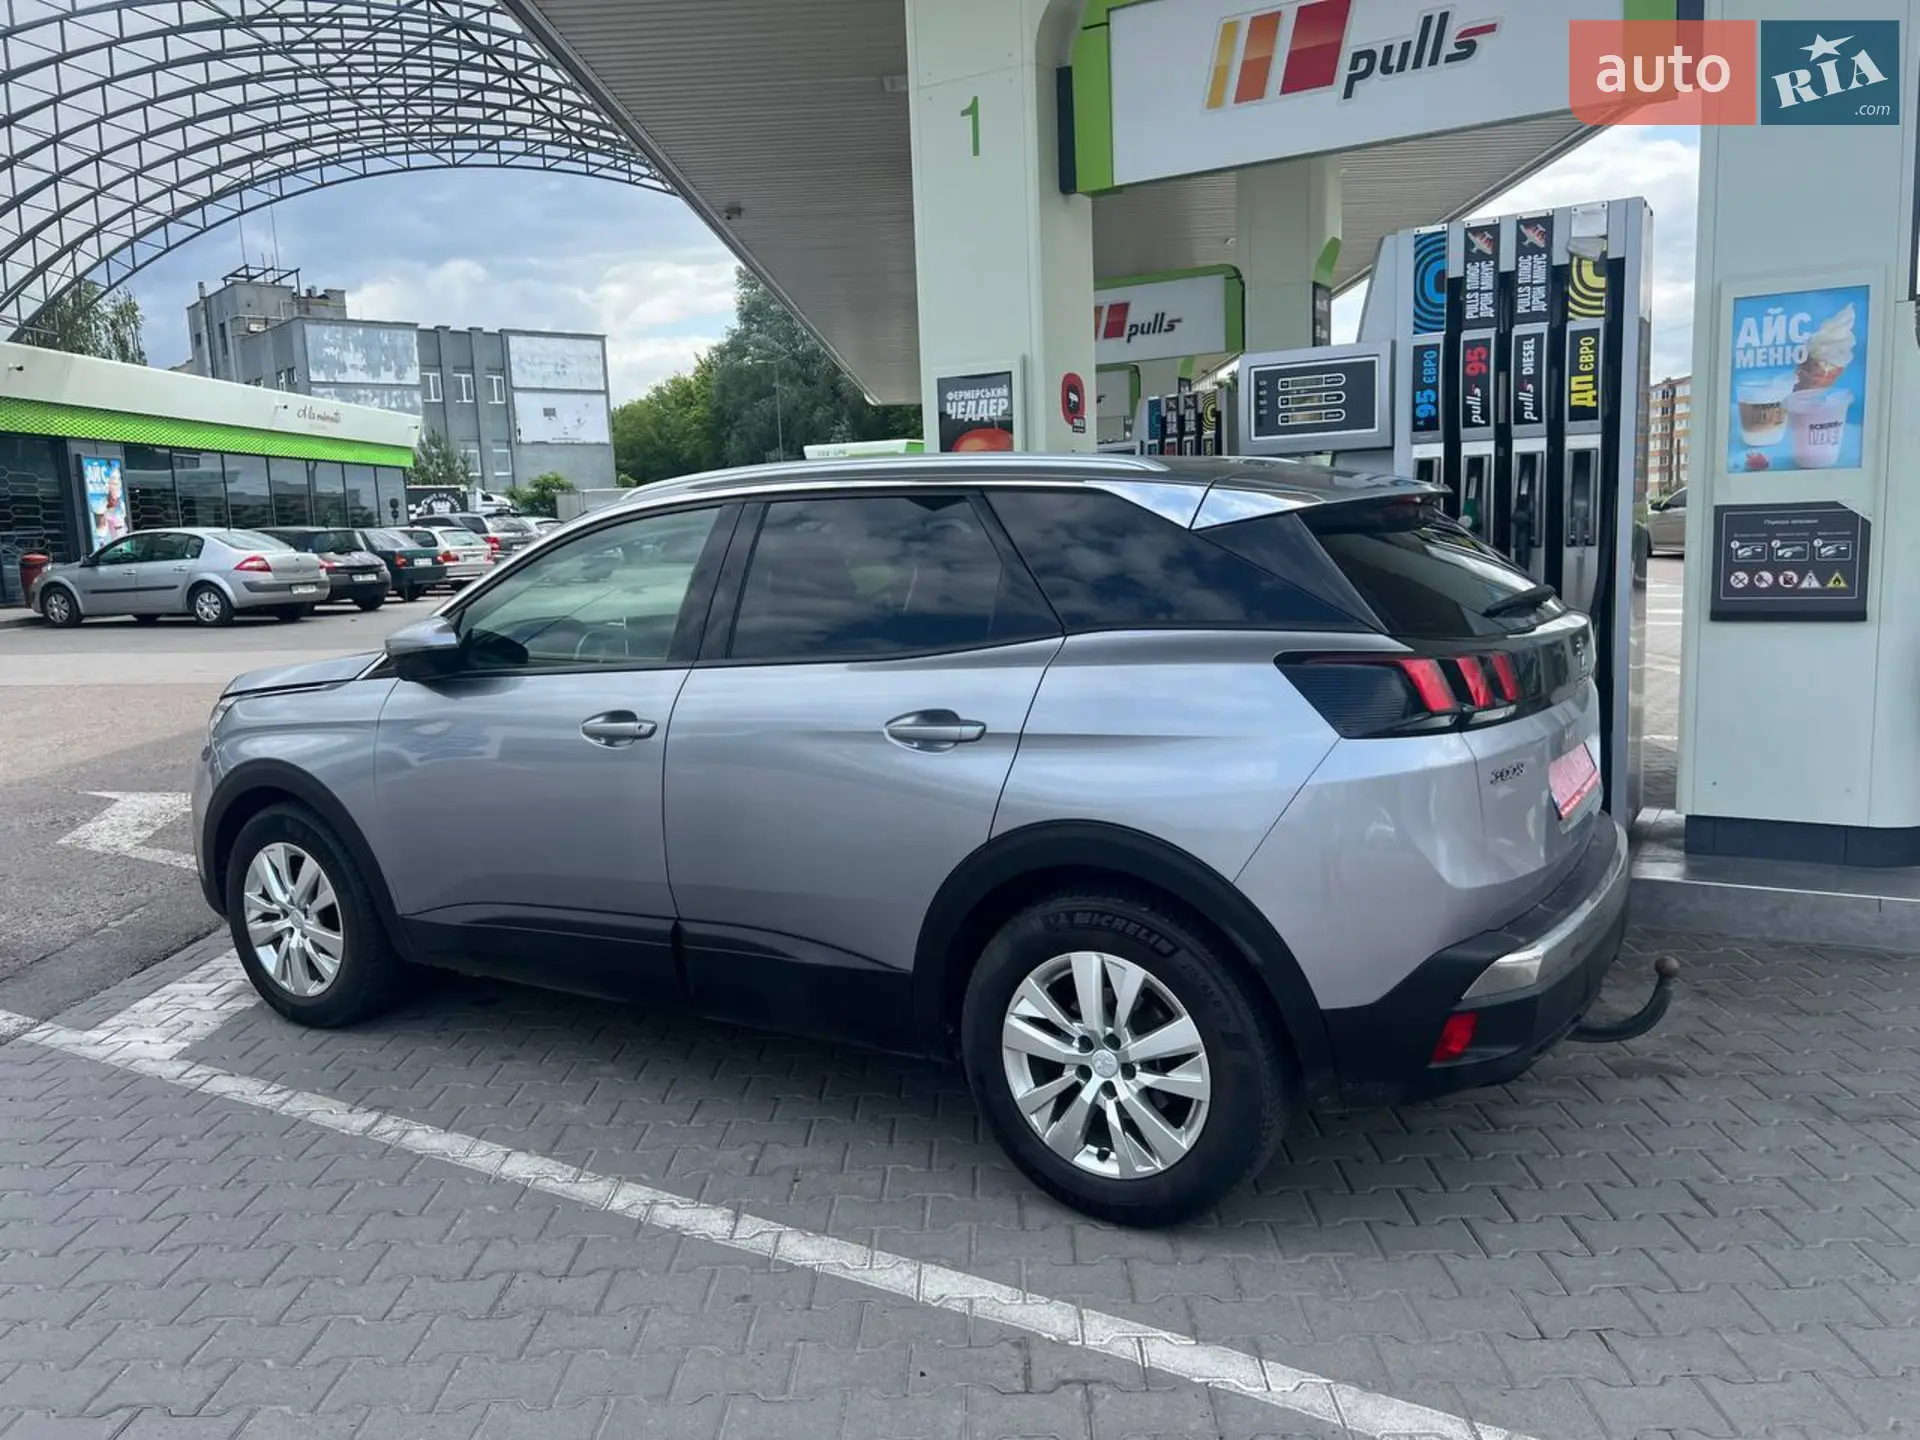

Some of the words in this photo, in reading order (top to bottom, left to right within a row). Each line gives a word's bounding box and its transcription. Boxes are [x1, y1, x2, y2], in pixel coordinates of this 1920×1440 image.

[1342, 11, 1498, 100] pulls
[960, 96, 980, 156] 1
[1467, 262, 1480, 290] ПЛЮС
[1518, 255, 1532, 285] ПЛЮС
[1466, 291, 1479, 319] PULLS
[1480, 292, 1494, 318] ДРОН
[1517, 285, 1530, 313] PULLS
[1532, 286, 1547, 312] ДРОН
[1127, 312, 1182, 344] pulls
[1737, 306, 1813, 349] АЙС
[1423, 350, 1437, 383] ЄВРО
[1466, 346, 1488, 377] 95
[1522, 337, 1535, 376] DIESEL
[1579, 336, 1595, 371] ЄВРО
[1735, 345, 1809, 369] МЕНЮ
[946, 384, 1009, 401] ФЕРМЕРСЬКИЙ
[1466, 384, 1486, 424] pulls
[1518, 380, 1538, 420] pulls
[1571, 375, 1597, 407] ДП
[946, 399, 1009, 422] ЧЕДДЕР
[1073, 911, 1177, 955] MICHELIN
